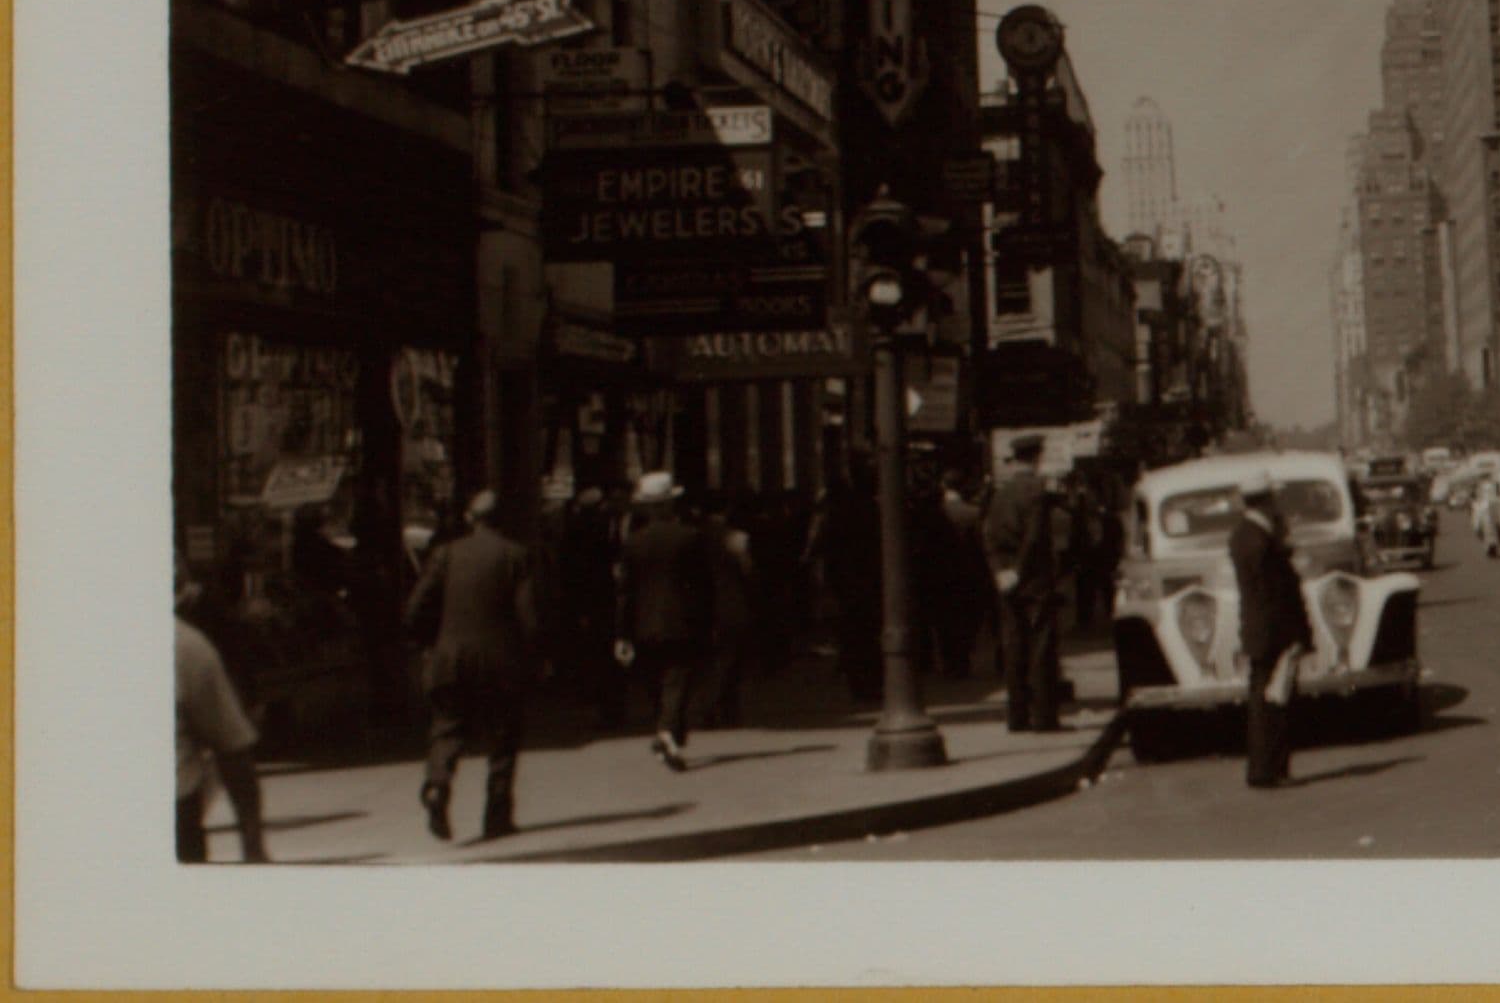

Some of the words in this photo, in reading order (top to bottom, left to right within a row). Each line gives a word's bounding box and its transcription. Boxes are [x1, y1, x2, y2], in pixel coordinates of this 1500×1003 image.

[597, 165, 728, 202] EMPIRE
[569, 204, 762, 244] JEWELERS
[686, 328, 852, 359] AUTOMAT
